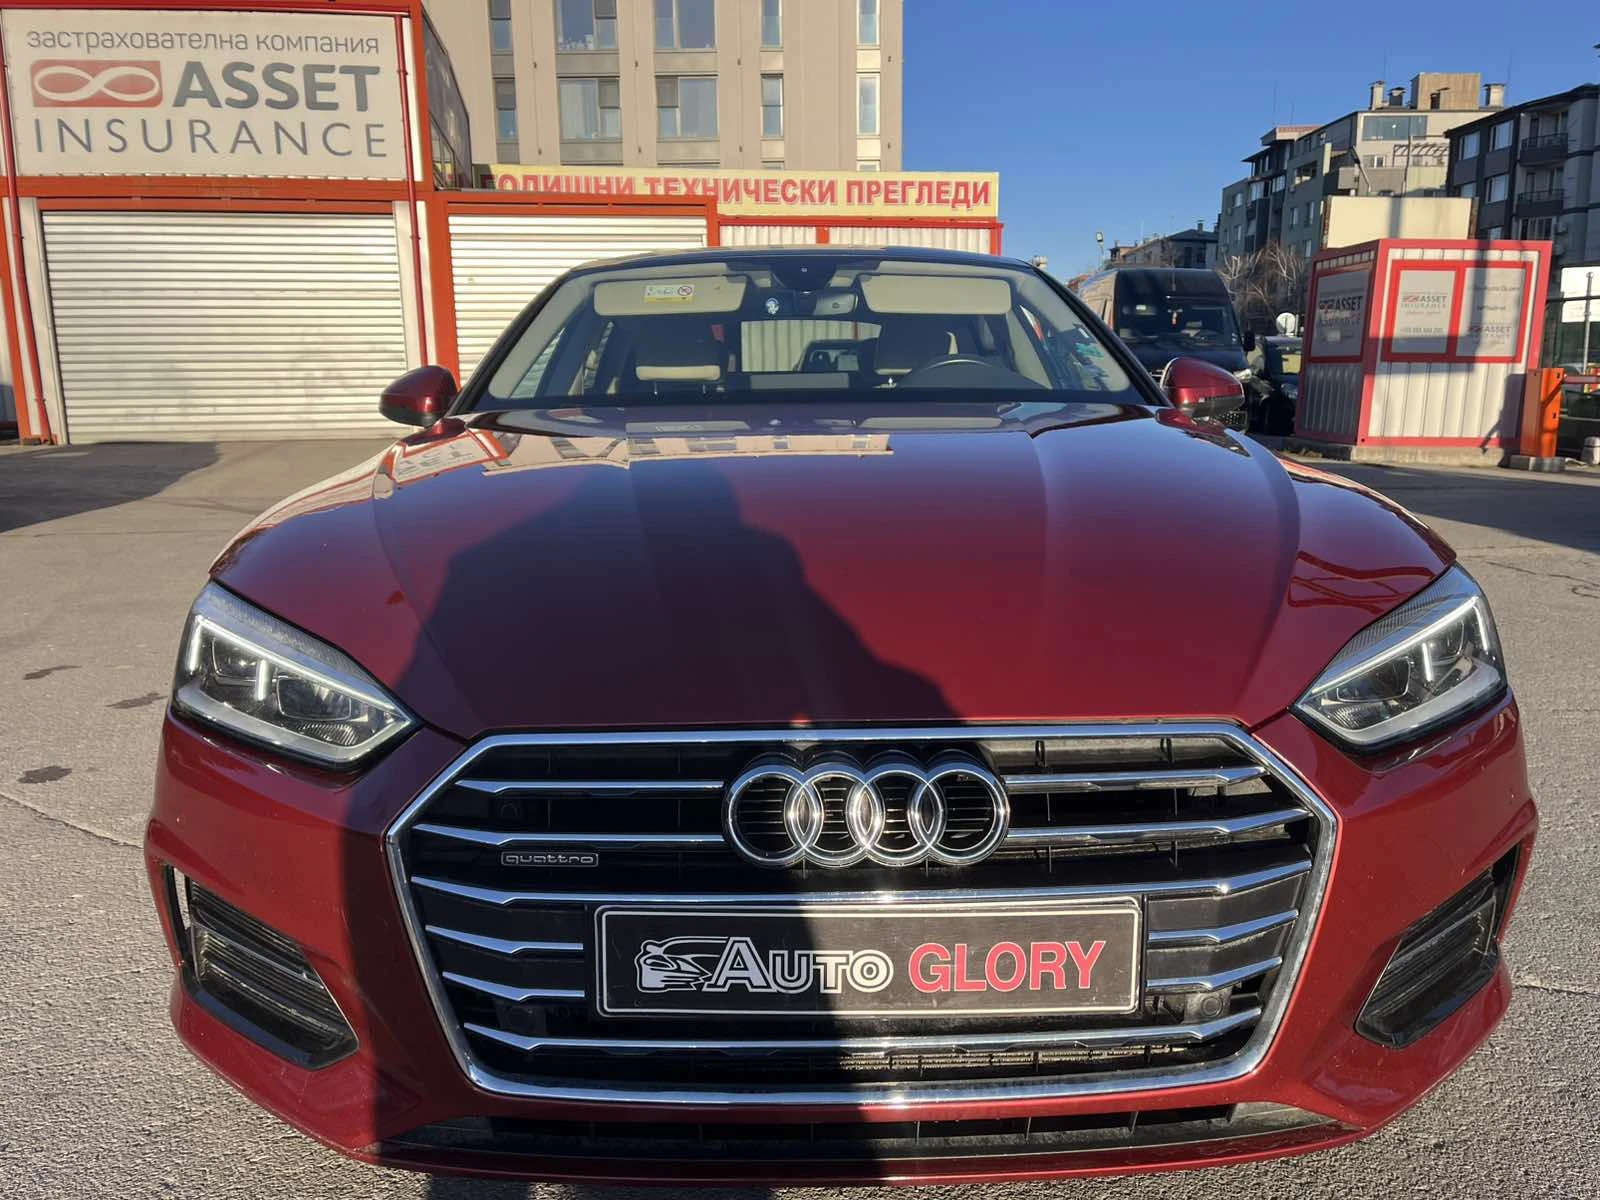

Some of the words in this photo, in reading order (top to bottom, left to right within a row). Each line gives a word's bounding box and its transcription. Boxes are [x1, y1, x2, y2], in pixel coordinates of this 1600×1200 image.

[27, 31, 248, 53] застрахователна
[256, 34, 379, 54] компания
[172, 61, 380, 112] ASSET
[34, 118, 387, 157] INSURANCE
[643, 176, 837, 205] ТЕХНИЧЕСКИ
[846, 179, 991, 208] ПРЕГЛЕДИ
[1336, 296, 1363, 311] ASSET
[1420, 295, 1448, 303] ASSET
[505, 854, 595, 865] quattro
[908, 941, 1106, 993] GLORY
